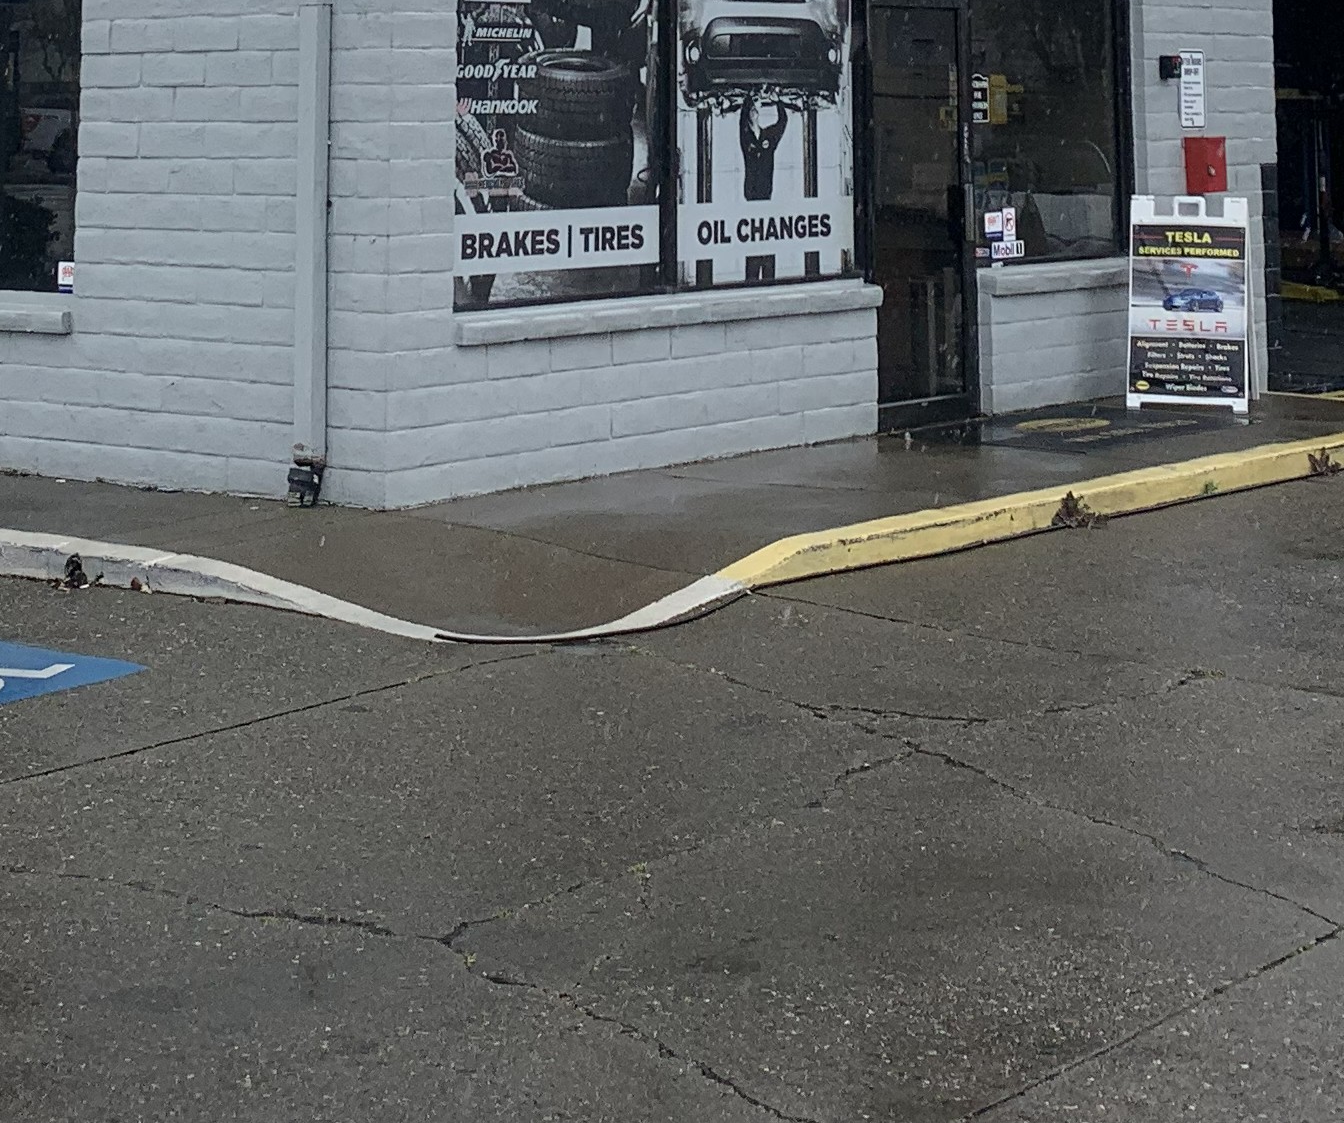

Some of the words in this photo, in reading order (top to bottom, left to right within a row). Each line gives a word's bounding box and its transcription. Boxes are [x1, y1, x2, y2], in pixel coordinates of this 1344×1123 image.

[475, 27, 533, 39] MICHELIN
[696, 219, 732, 246] OIL
[736, 213, 832, 243] CHANGES
[460, 228, 561, 260] BRAKES
[579, 223, 645, 253] TIRES
[1164, 230, 1212, 245] TESLA
[1138, 245, 1183, 256] SERVICES
[1183, 246, 1240, 257] PERFORMED
[1149, 319, 1228, 333] TESLA
